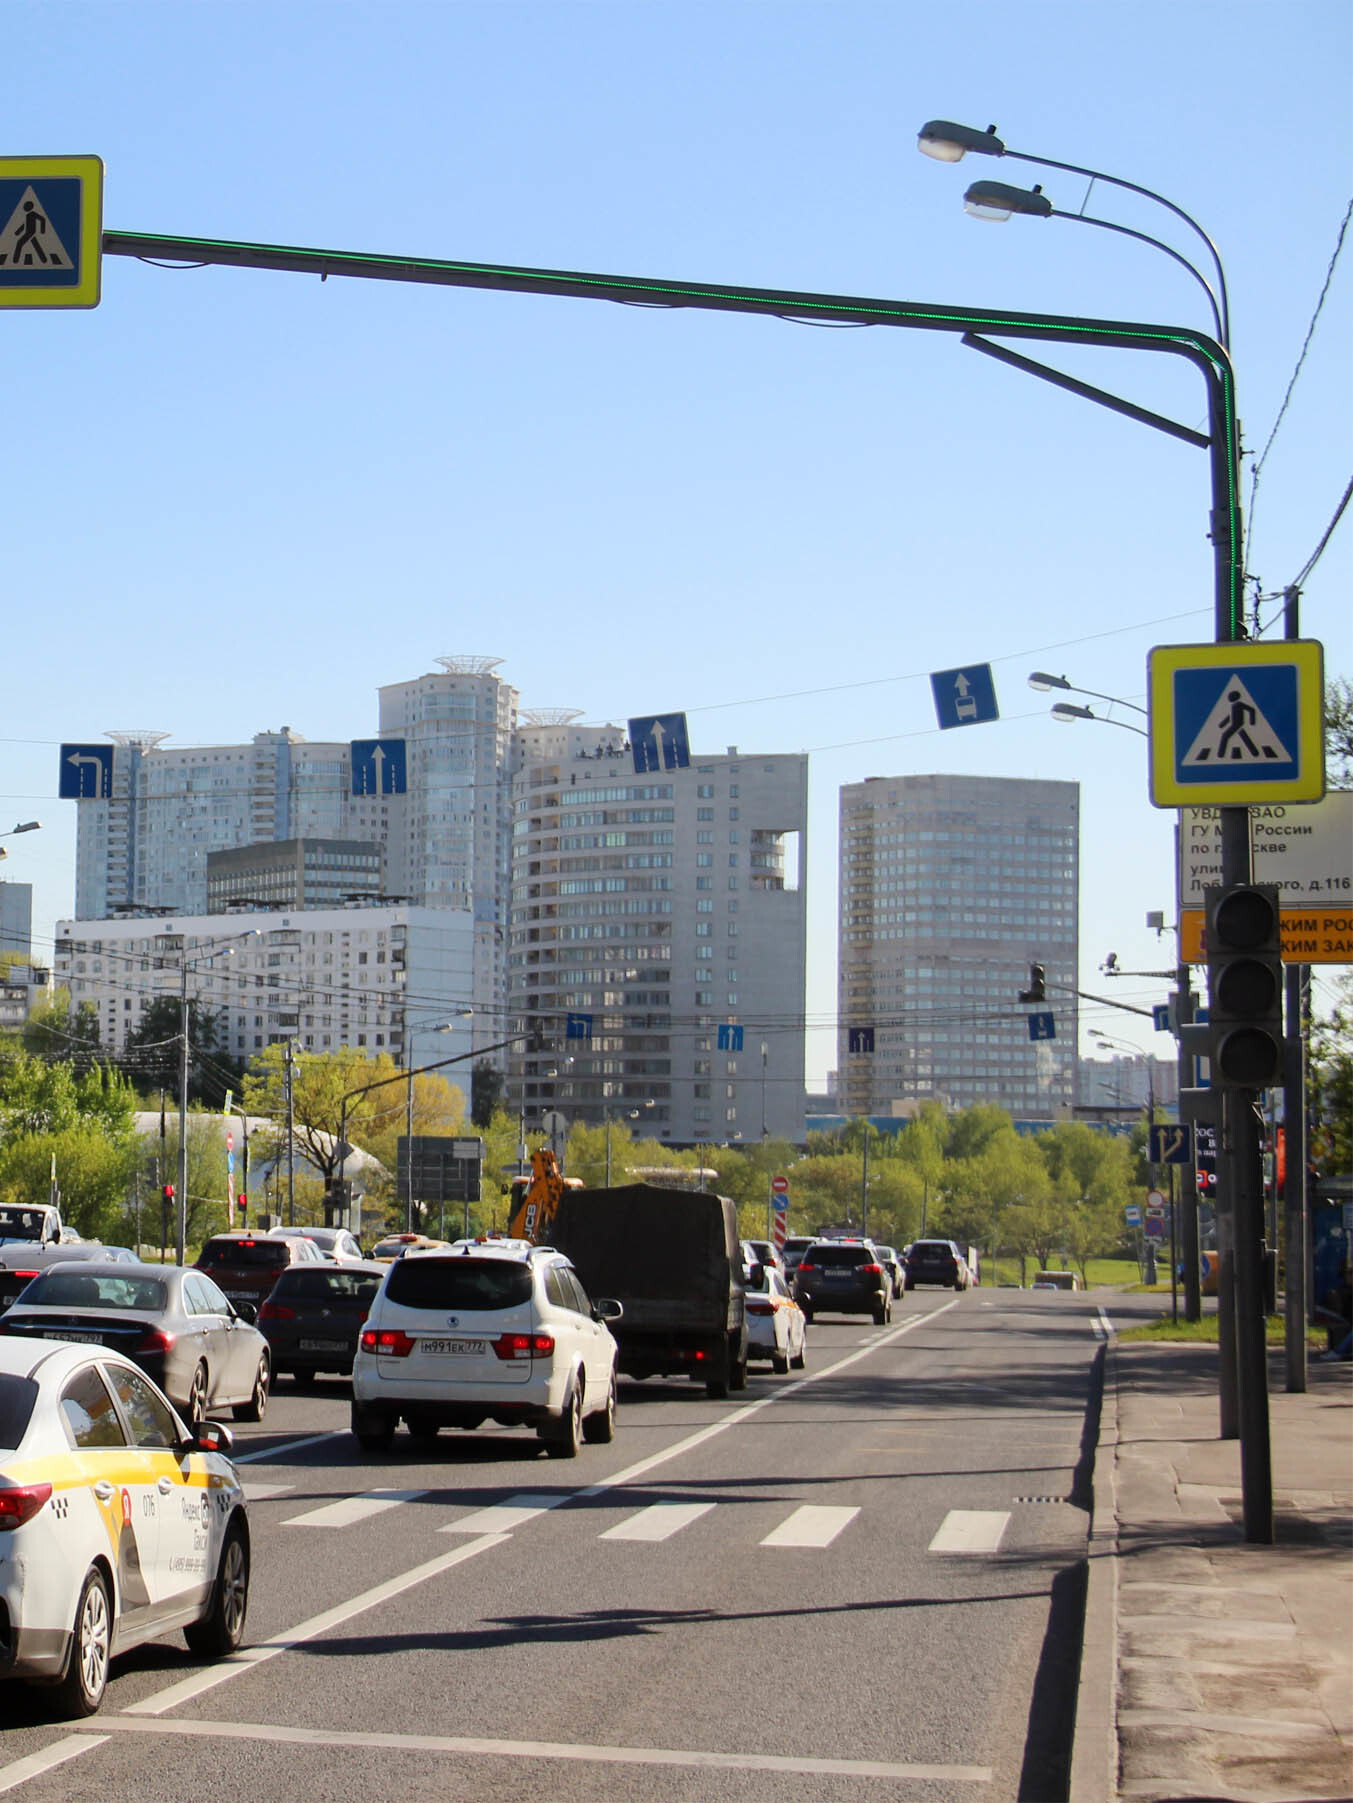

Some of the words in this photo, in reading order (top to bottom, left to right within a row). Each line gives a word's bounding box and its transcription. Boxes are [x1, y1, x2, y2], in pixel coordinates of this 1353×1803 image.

[1192, 825, 1209, 837] ГУ
[1255, 824, 1314, 836] России
[1191, 844, 1210, 854] по
[525, 1203, 537, 1239] JCB
